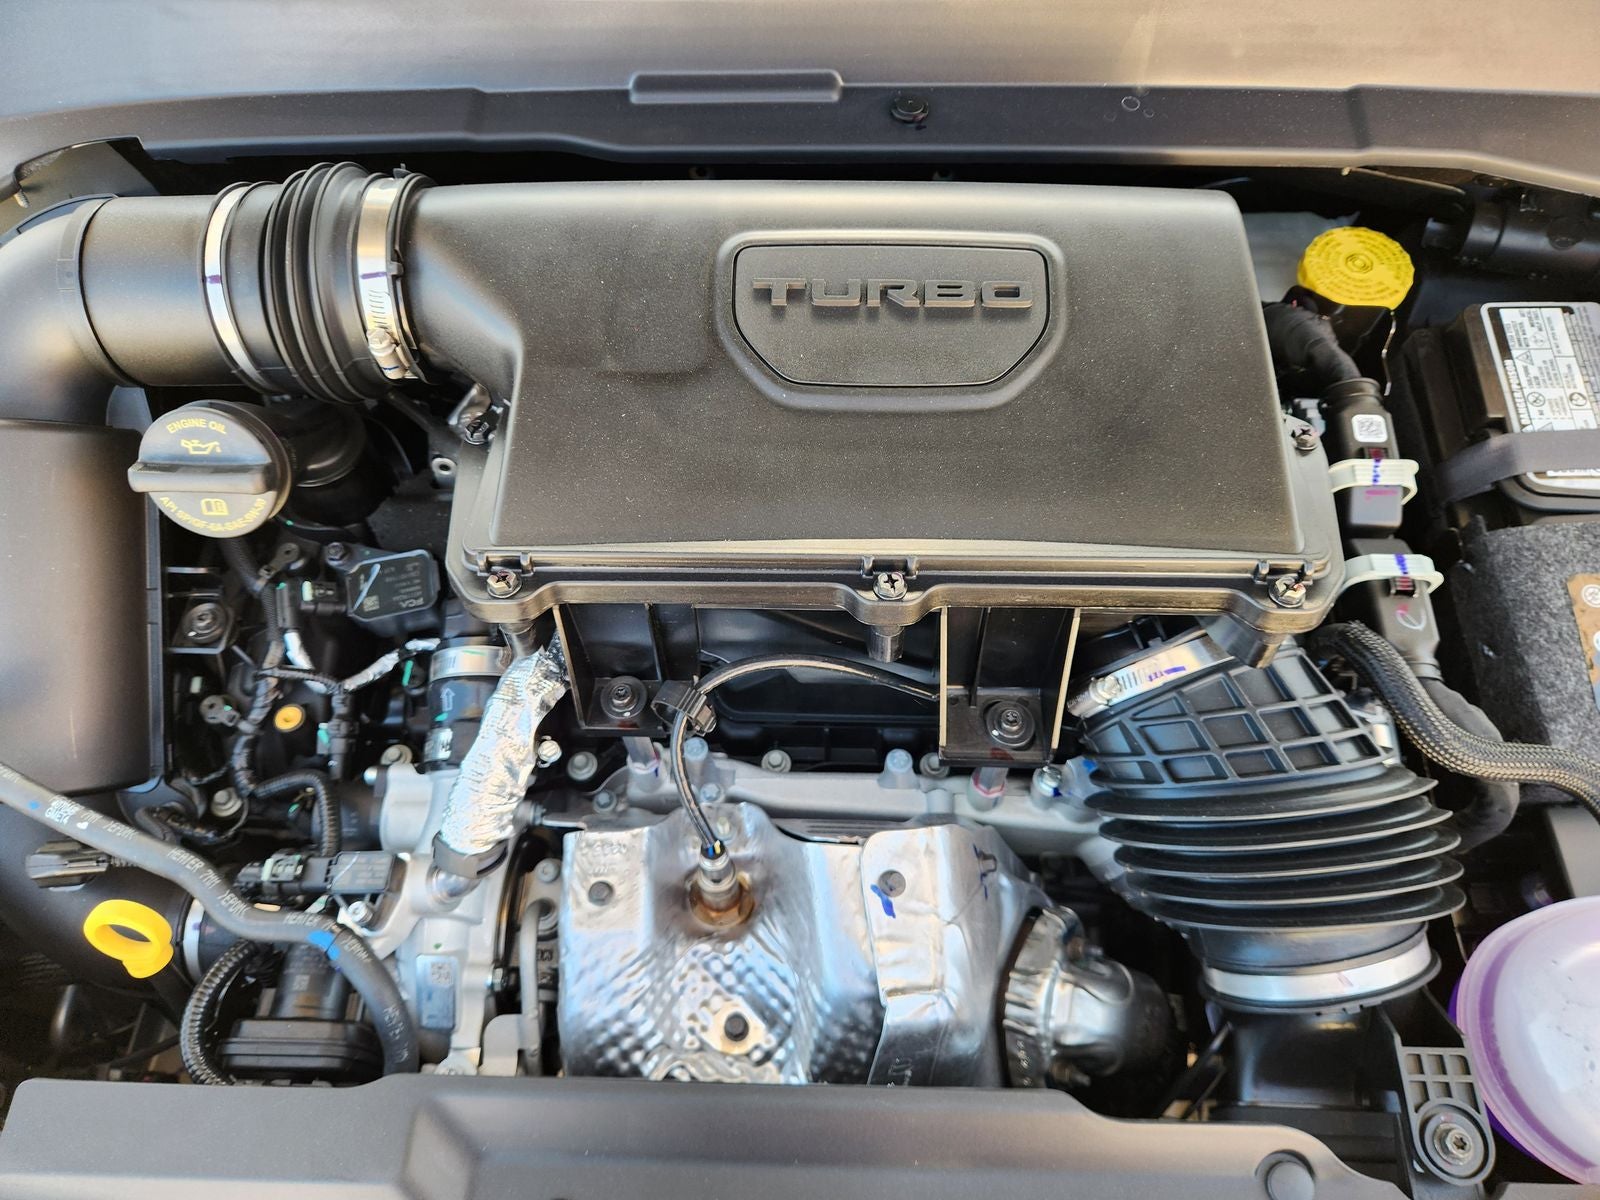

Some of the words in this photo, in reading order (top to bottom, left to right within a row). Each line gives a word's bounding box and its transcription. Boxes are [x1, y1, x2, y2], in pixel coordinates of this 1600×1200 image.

[753, 278, 1032, 309] TURBO
[166, 418, 207, 434] ENGINE
[209, 421, 226, 435] OIL
[167, 847, 205, 873] HEATER
